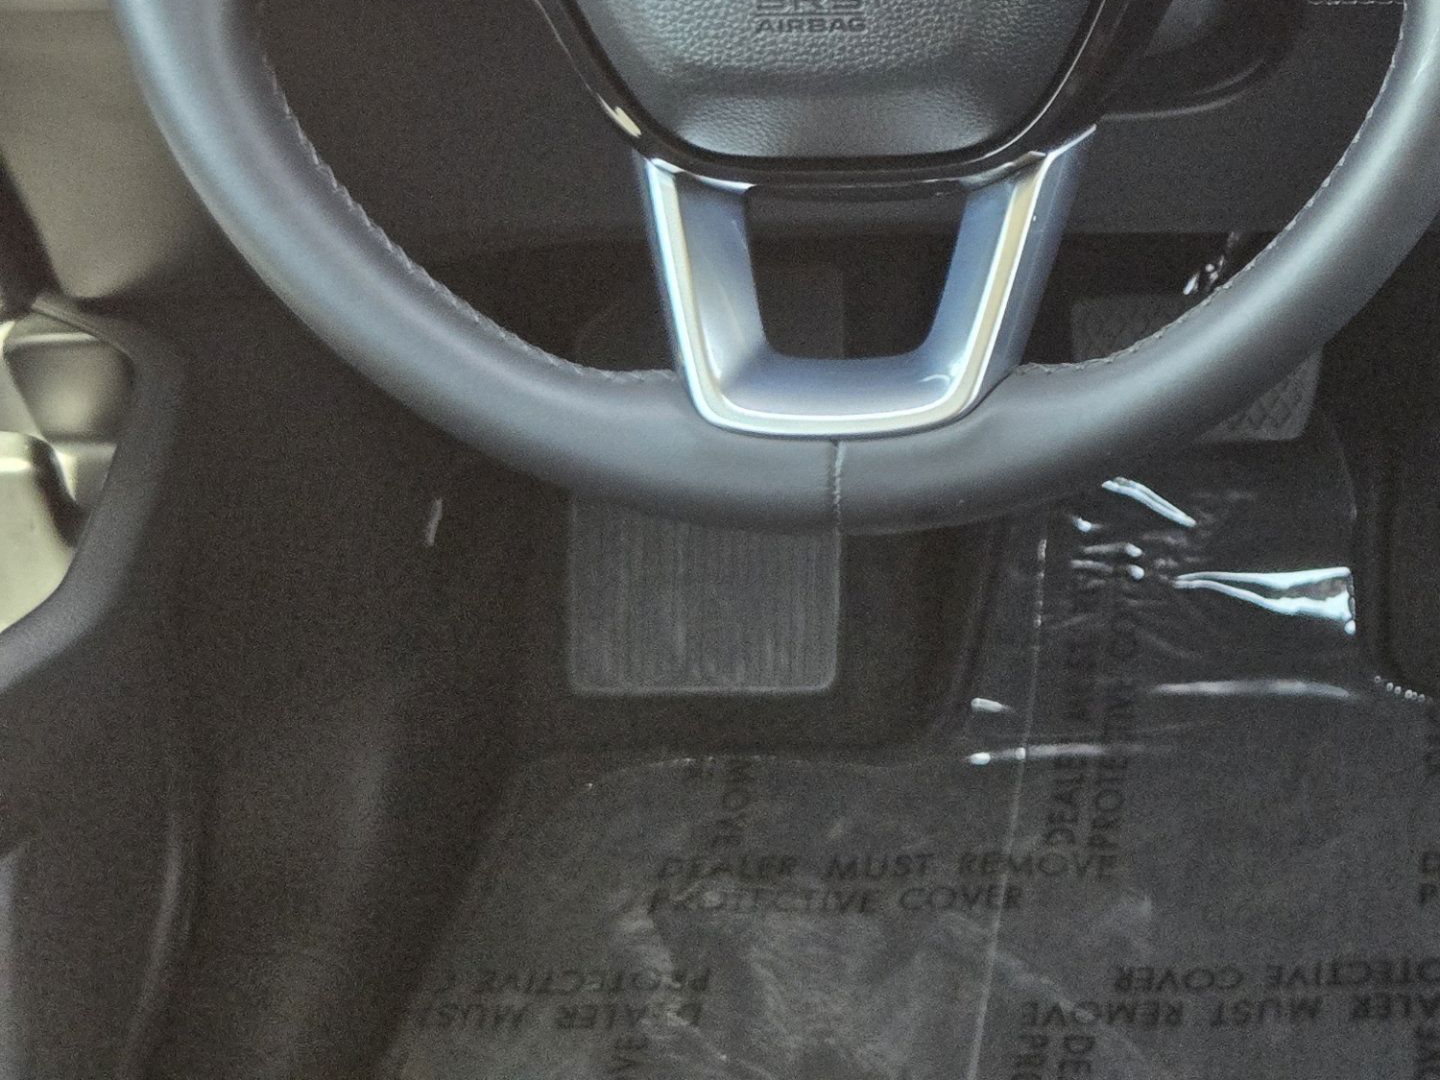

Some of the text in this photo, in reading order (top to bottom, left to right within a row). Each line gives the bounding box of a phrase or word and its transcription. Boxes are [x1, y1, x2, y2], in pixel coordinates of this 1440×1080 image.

[756, 18, 867, 33] AIRBAG
[658, 849, 1118, 882] DEALER MUST REMOVE
[899, 884, 1023, 911] COVER
[1113, 965, 1244, 993] COVER
[556, 1002, 703, 1030] DALER
[1020, 999, 1184, 1030] REMOVE
[1209, 996, 1322, 1027] MUST
